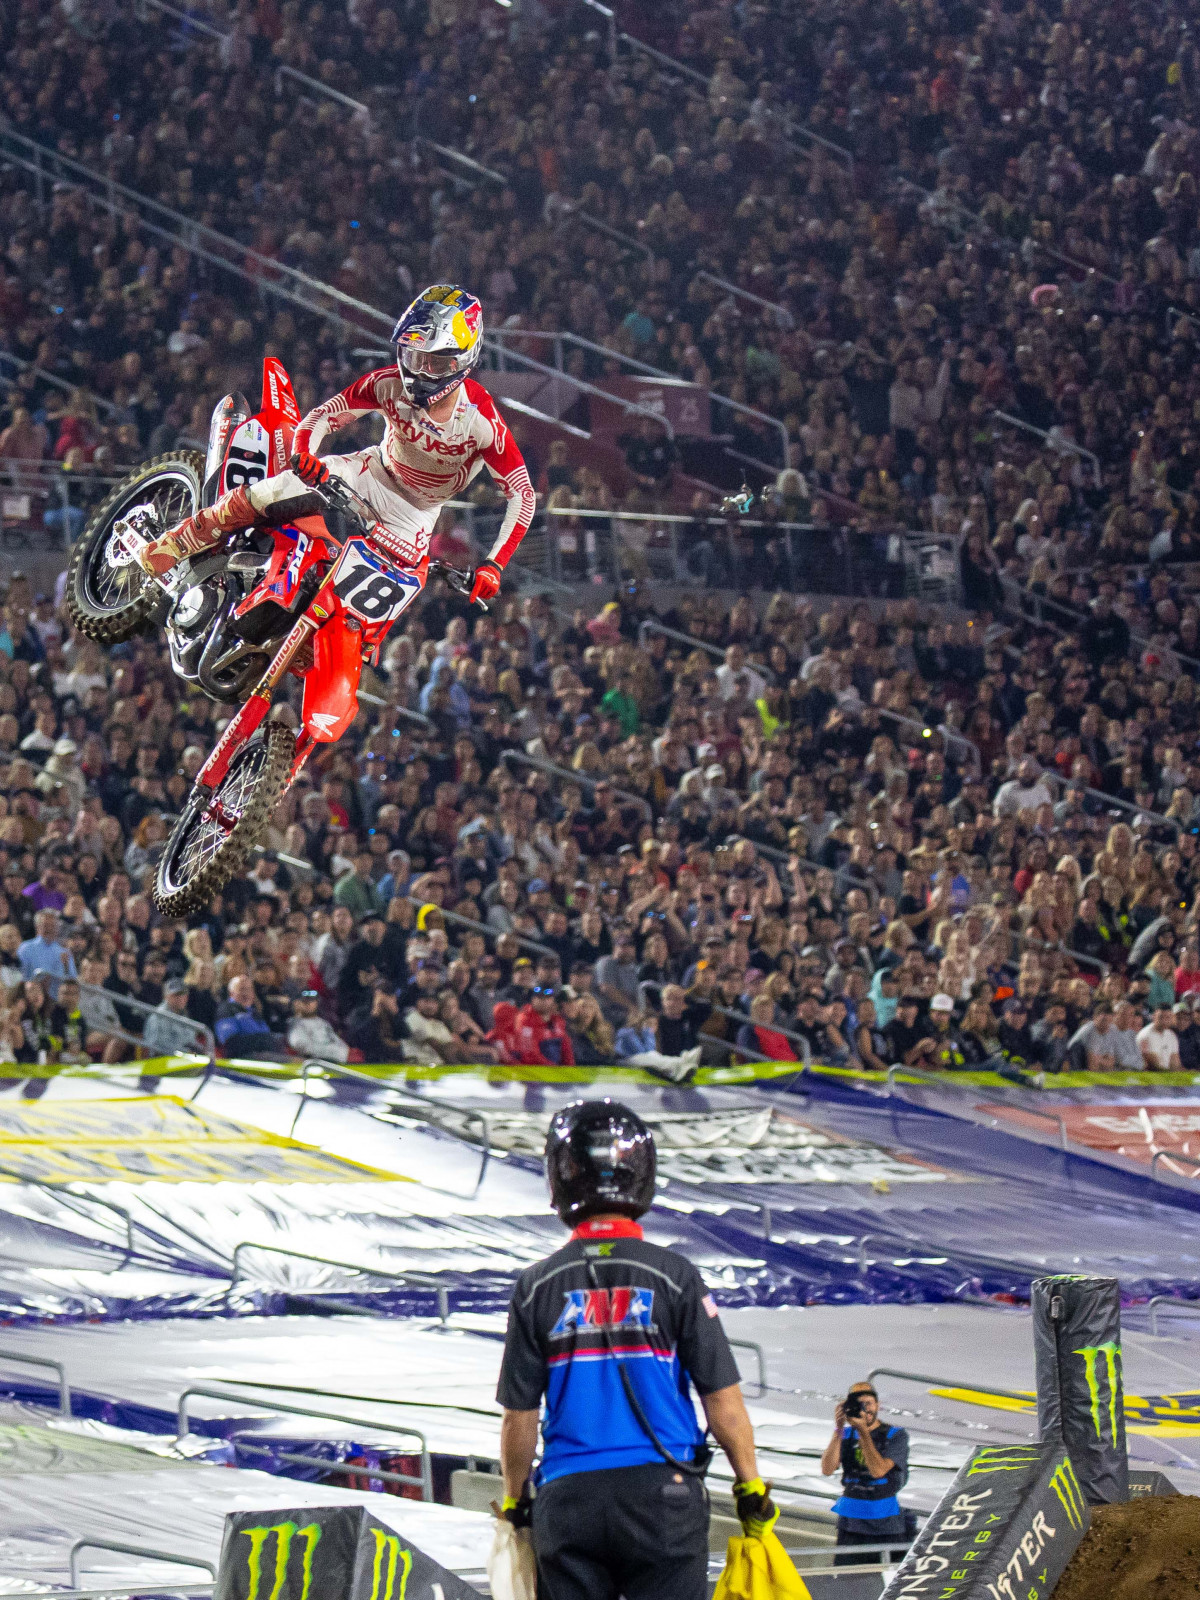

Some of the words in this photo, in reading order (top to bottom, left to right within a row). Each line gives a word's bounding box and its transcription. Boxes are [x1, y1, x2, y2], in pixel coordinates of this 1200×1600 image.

[268, 371, 280, 409] DUNLOP
[274, 428, 287, 470] HONDA
[422, 434, 478, 457] years
[288, 531, 309, 588] CRF
[373, 532, 415, 563] RENTHAL
[333, 564, 406, 620] 18
[206, 713, 243, 772] DUNLOP
[549, 1286, 658, 1341] AMA
[896, 1488, 993, 1600] NSTER
[938, 1513, 1001, 1600] NERGY
